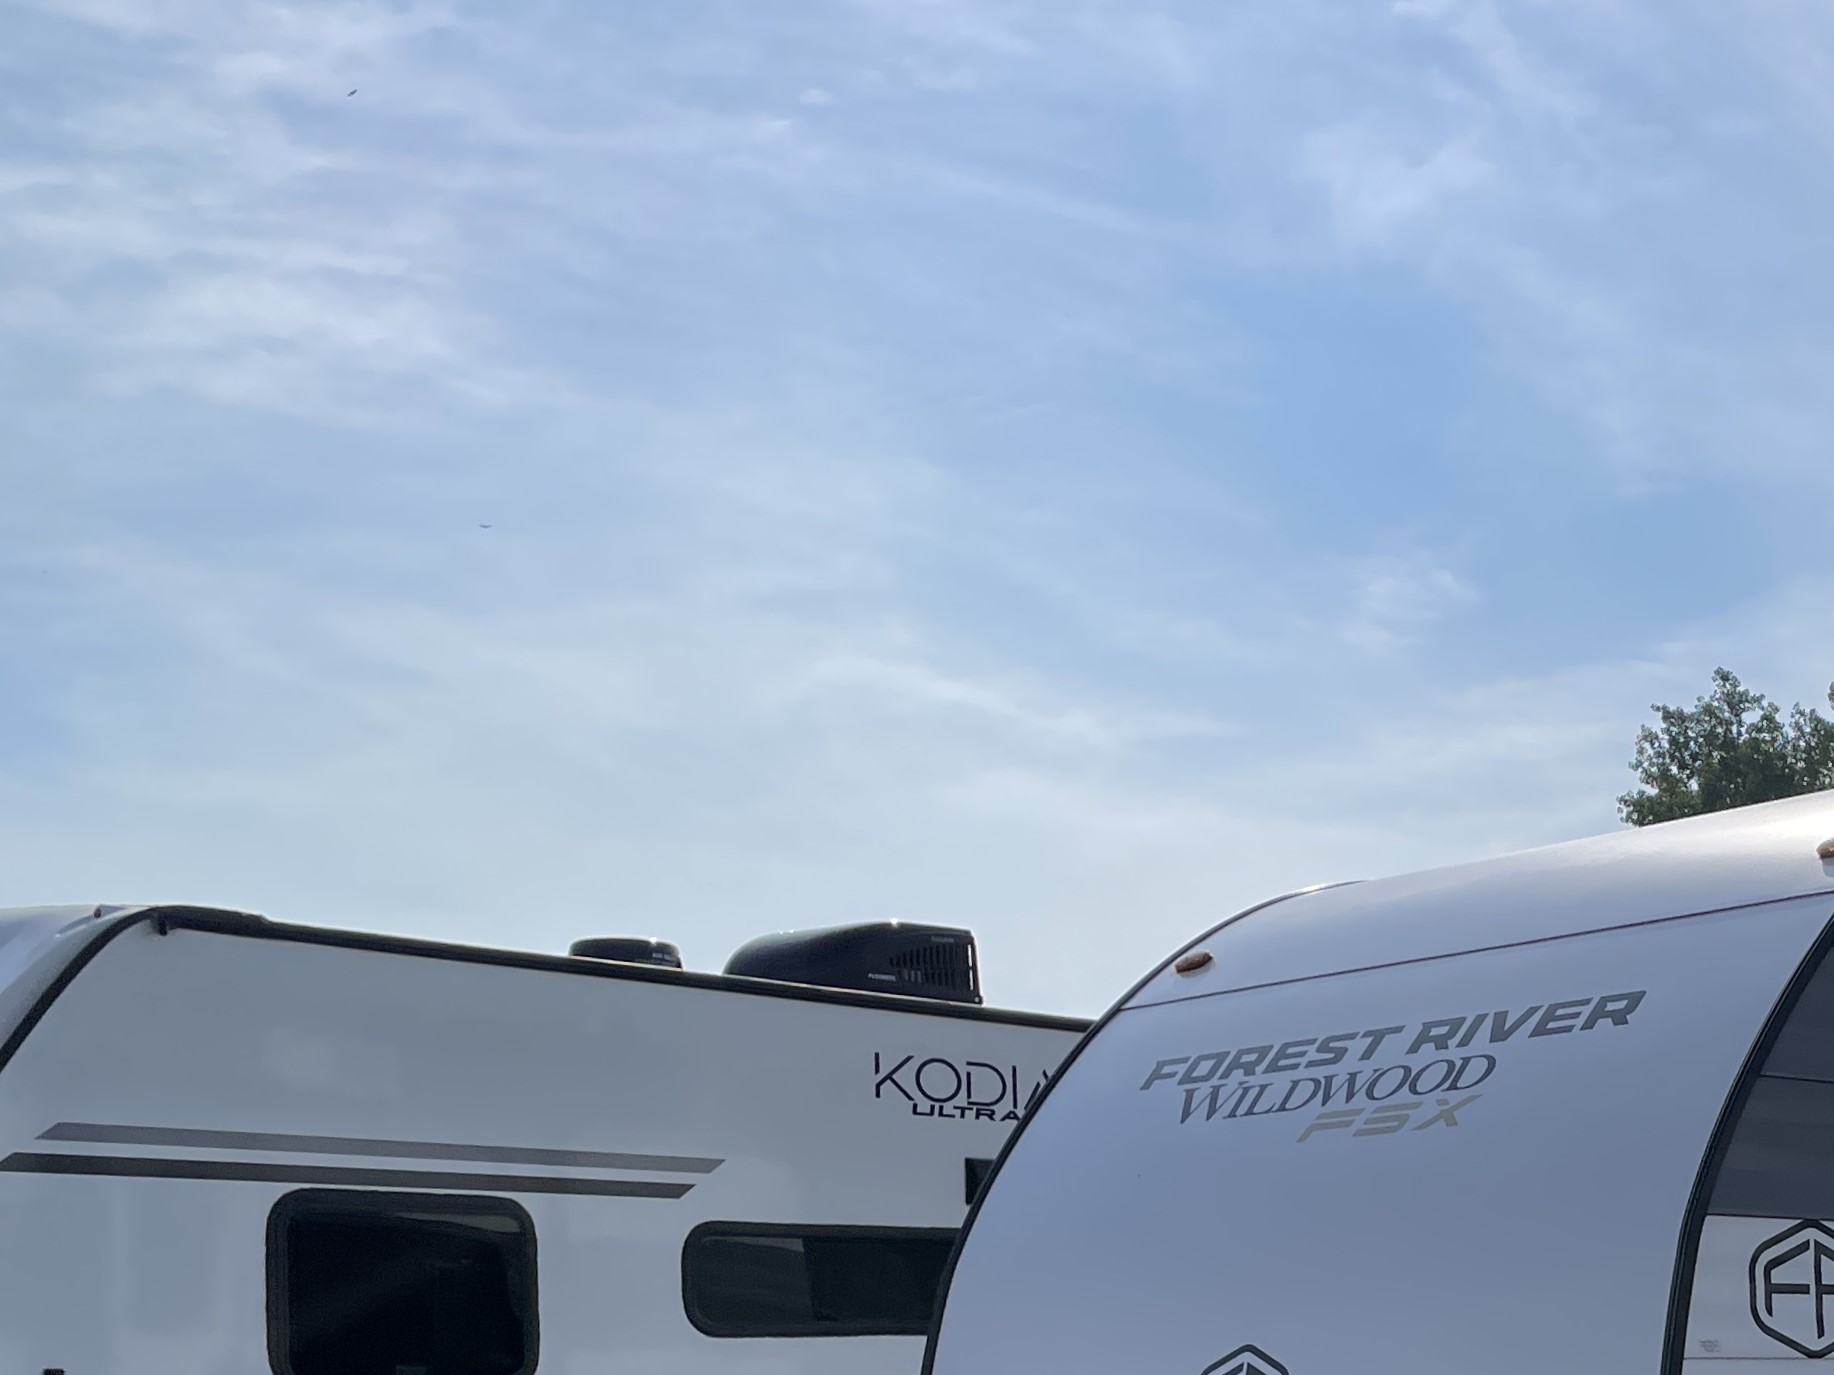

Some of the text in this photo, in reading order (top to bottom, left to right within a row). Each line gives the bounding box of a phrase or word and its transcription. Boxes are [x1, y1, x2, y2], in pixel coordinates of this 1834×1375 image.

[1140, 990, 1648, 1091] FOREST RIVER
[911, 1103, 1023, 1122] ULTRA
[1179, 1053, 1498, 1125] WILDWOOD
[1296, 1093, 1484, 1144] FSX
